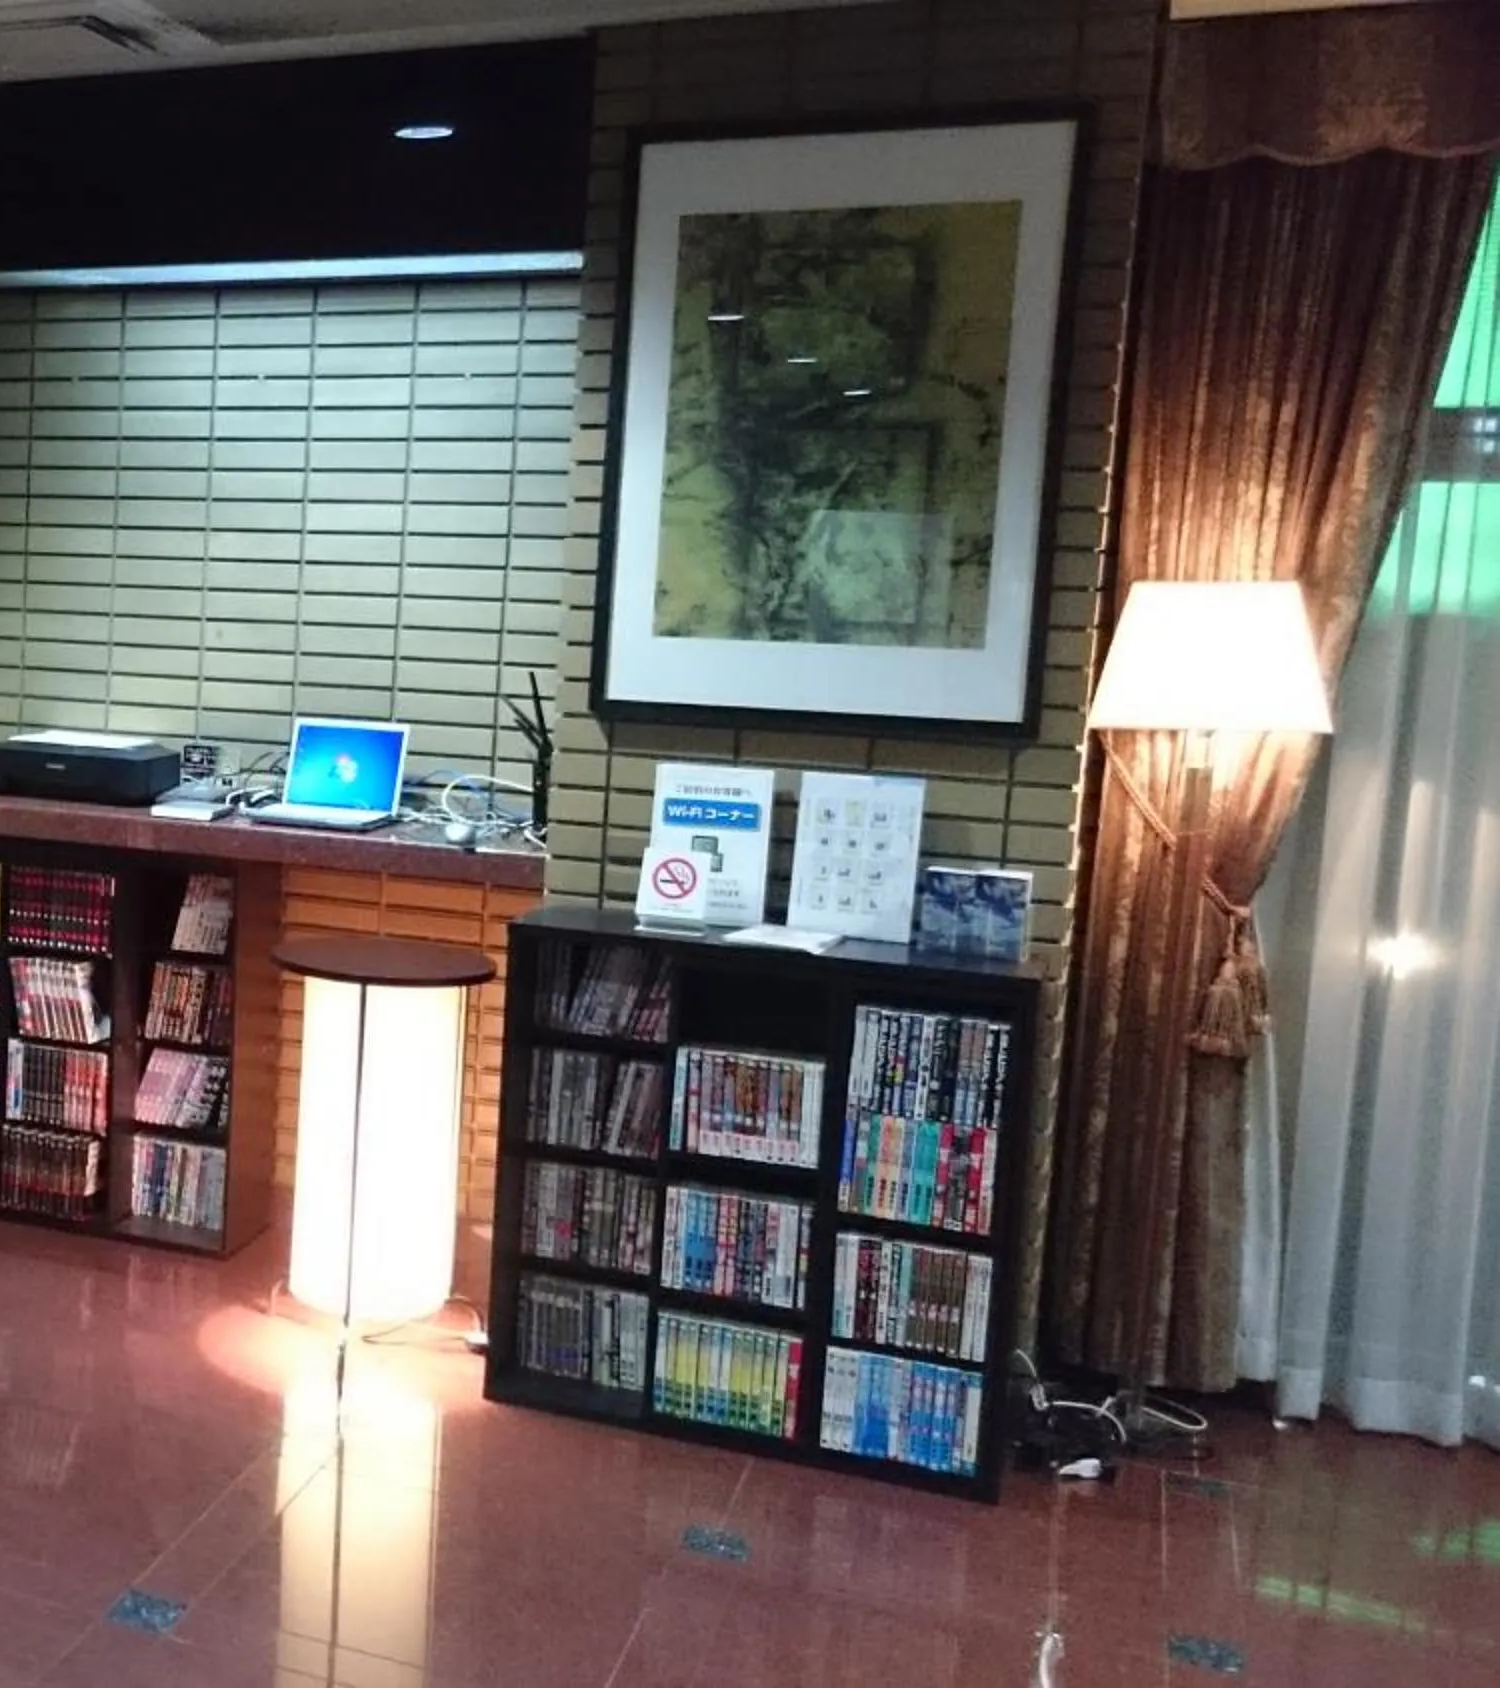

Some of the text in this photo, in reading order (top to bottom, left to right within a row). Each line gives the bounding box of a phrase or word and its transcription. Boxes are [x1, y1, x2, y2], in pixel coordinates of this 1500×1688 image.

[667, 804, 756, 821] Wi-Fi コーナー
